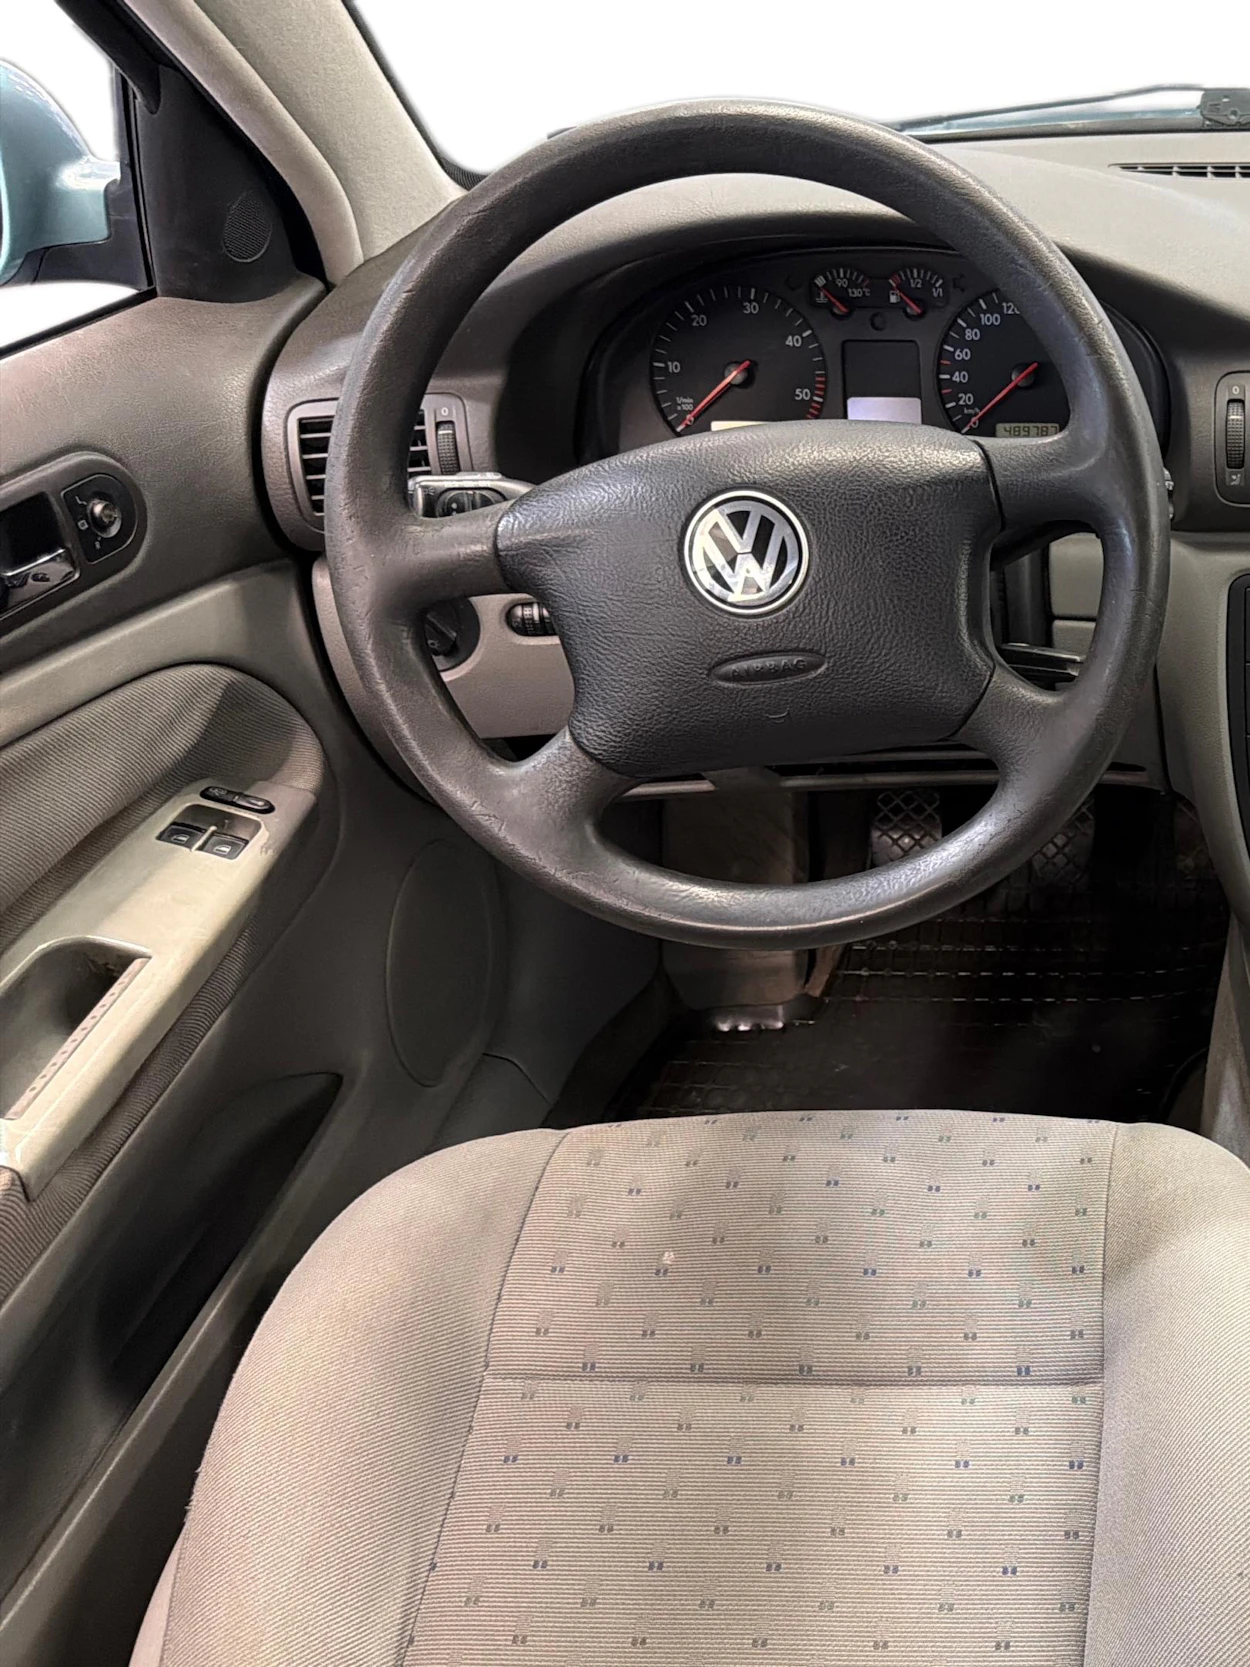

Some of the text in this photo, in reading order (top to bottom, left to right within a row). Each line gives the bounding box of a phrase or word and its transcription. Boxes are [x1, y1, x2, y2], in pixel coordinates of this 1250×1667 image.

[836, 279, 848, 288] 90
[910, 279, 922, 288] 1/2
[743, 302, 759, 314] 30
[691, 315, 707, 326] 20
[980, 313, 1001, 326] 100
[965, 328, 981, 341] 80
[785, 335, 802, 347] 40
[954, 348, 971, 360] 60
[668, 361, 681, 373] 10
[952, 371, 969, 383] 40
[795, 388, 811, 400] 50
[958, 393, 974, 405] 20
[1004, 425, 1058, 437] 489787
